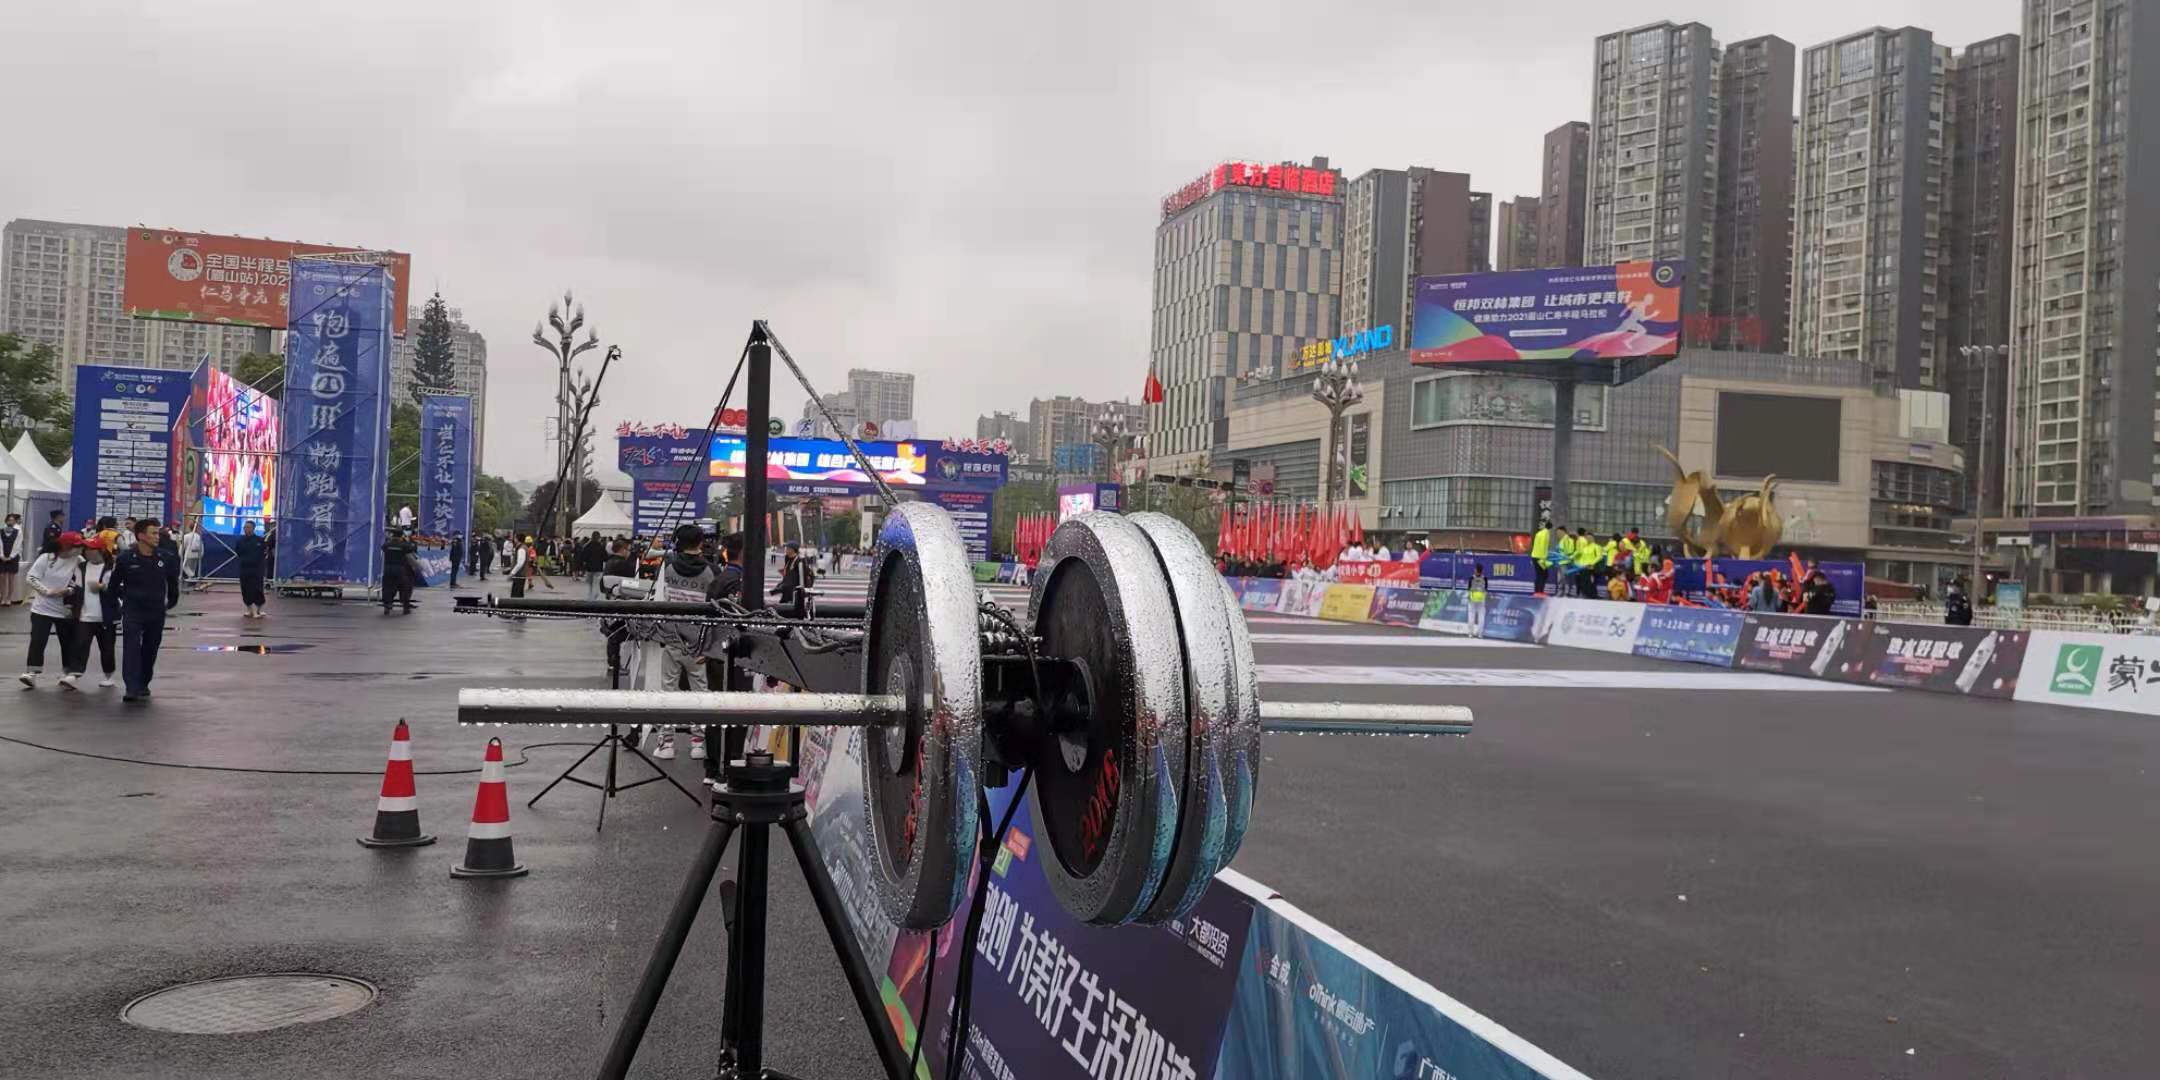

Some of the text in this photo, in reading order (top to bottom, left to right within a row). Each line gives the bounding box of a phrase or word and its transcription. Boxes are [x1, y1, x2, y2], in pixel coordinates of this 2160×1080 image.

[1544, 290, 1633, 307] 让城市更美好
[1188, 914, 1230, 959] 大都投资
